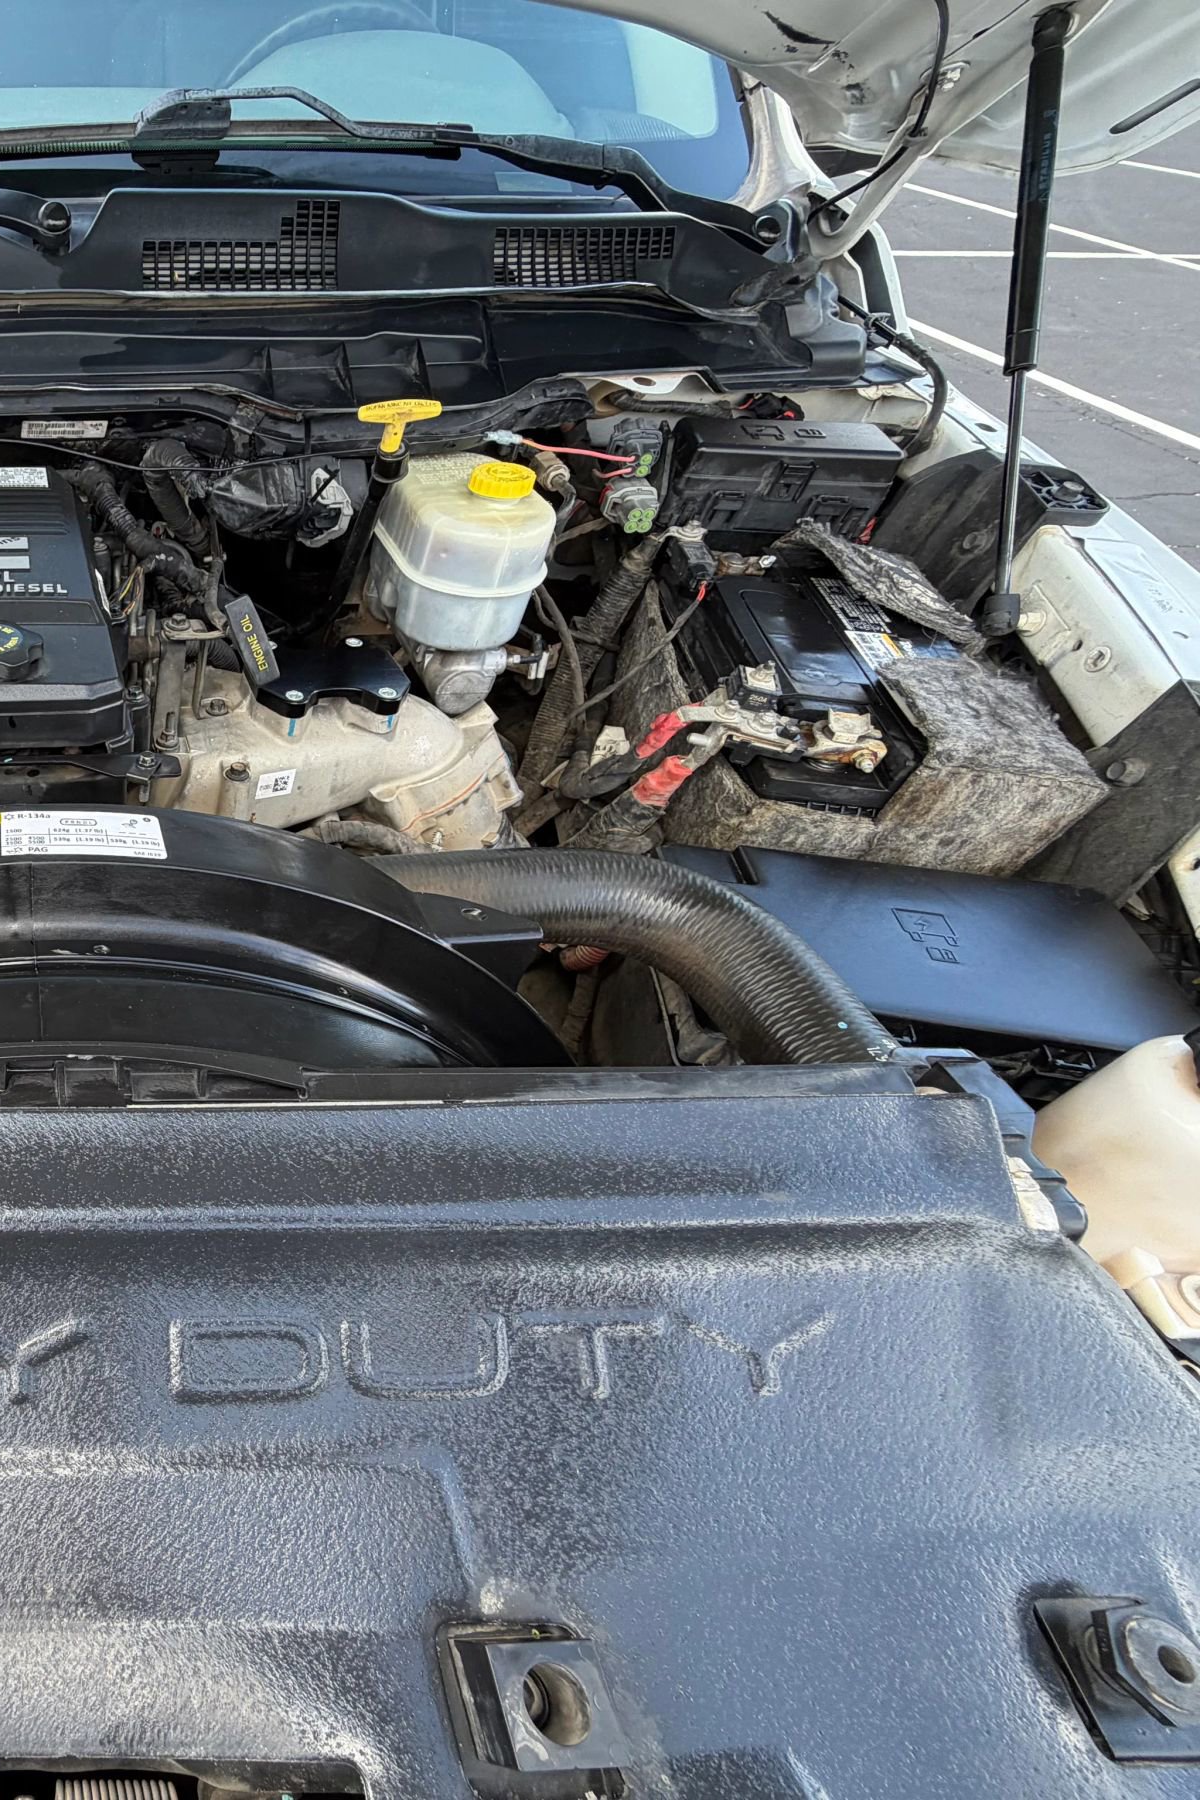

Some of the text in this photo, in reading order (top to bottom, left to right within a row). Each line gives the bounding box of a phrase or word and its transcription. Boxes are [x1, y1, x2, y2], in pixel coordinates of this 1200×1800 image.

[240, 613, 268, 672] ENGINE OIL
[17, 812, 51, 820] R-134a
[168, 1308, 836, 1406] DUTY
